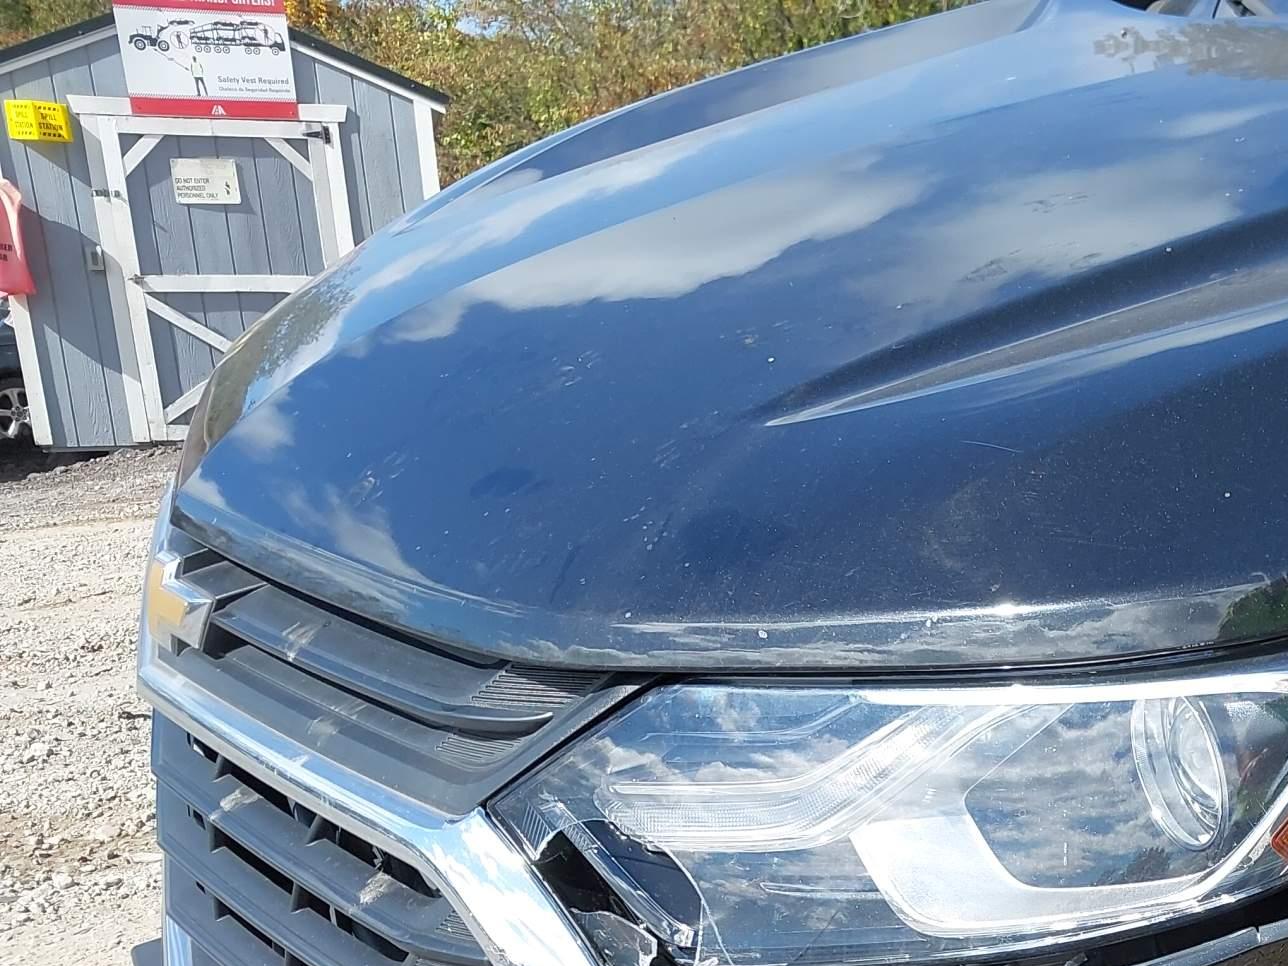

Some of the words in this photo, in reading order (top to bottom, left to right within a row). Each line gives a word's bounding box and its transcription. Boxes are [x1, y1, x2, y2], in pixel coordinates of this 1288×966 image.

[218, 76, 239, 85] Safety
[241, 76, 256, 84] Vest
[258, 77, 289, 86] Required
[40, 113, 56, 121] SPILL
[38, 122, 64, 131] STATION
